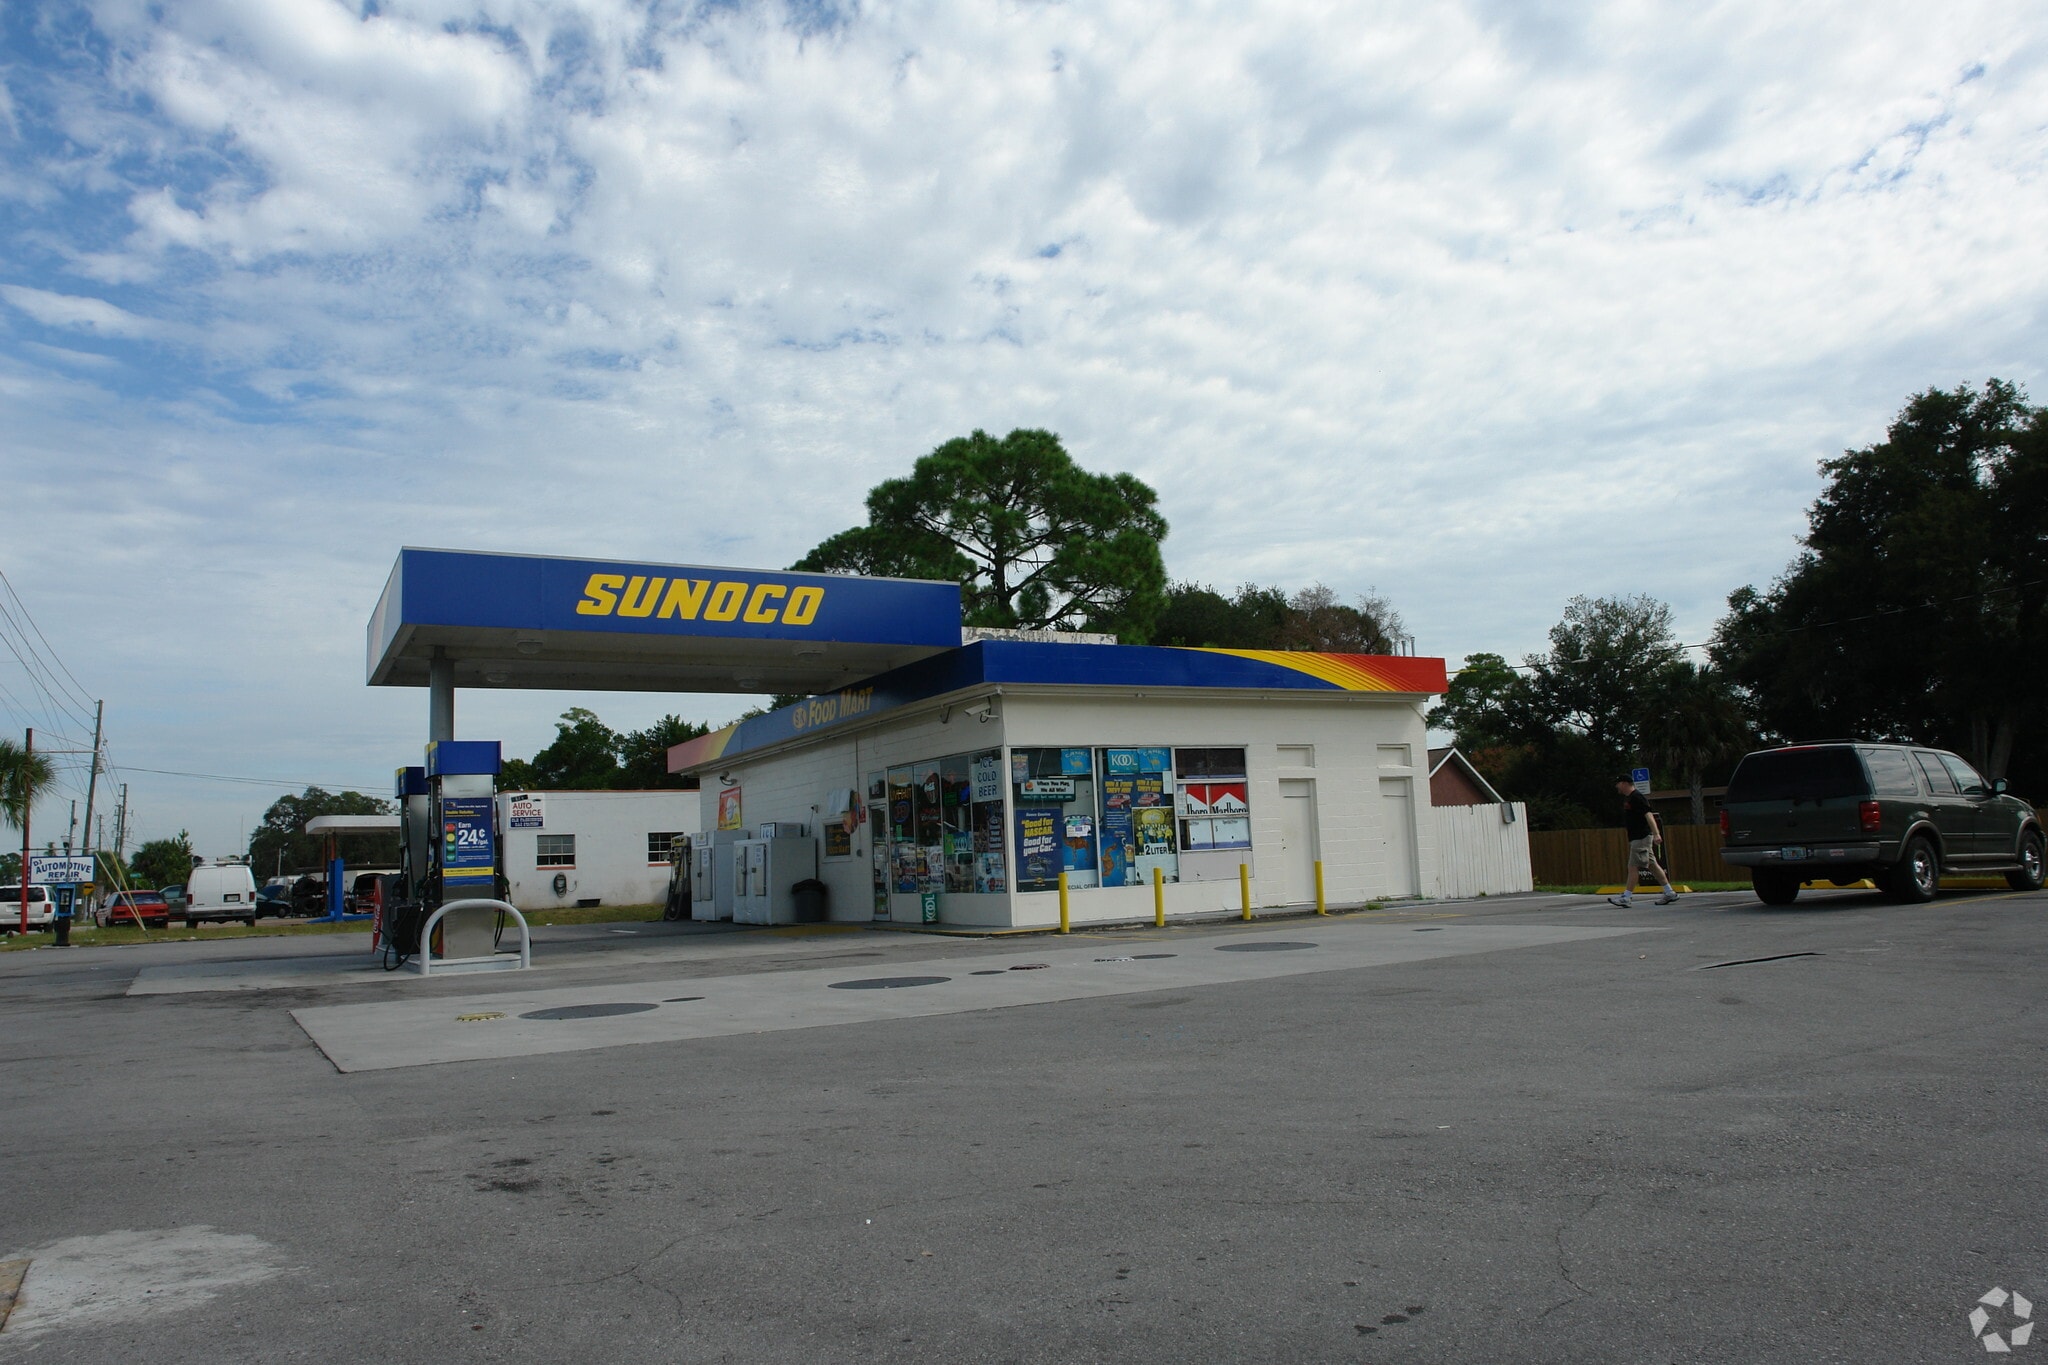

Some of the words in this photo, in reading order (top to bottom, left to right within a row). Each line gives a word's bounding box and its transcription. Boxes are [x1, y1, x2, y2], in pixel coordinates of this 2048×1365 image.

[575, 573, 825, 626] SUNOCO
[808, 698, 836, 728] FOOD
[839, 686, 874, 718] MART
[1143, 749, 1167, 758] CAMEL
[979, 756, 993, 769] ICE
[1111, 754, 1138, 766] KOOL
[977, 770, 997, 783] COLD
[978, 784, 997, 798] BEER
[512, 809, 542, 817] SERVICE
[762, 829, 774, 839] ICE
[1023, 836, 1041, 847] Good
[1041, 836, 1053, 845] for
[1023, 847, 1039, 857] your
[1145, 845, 1151, 855] 2
[1151, 846, 1168, 855] LITER
[33, 859, 42, 867] DJ
[36, 862, 92, 874] AUTOMOTIVE
[926, 894, 936, 922] KOOL
